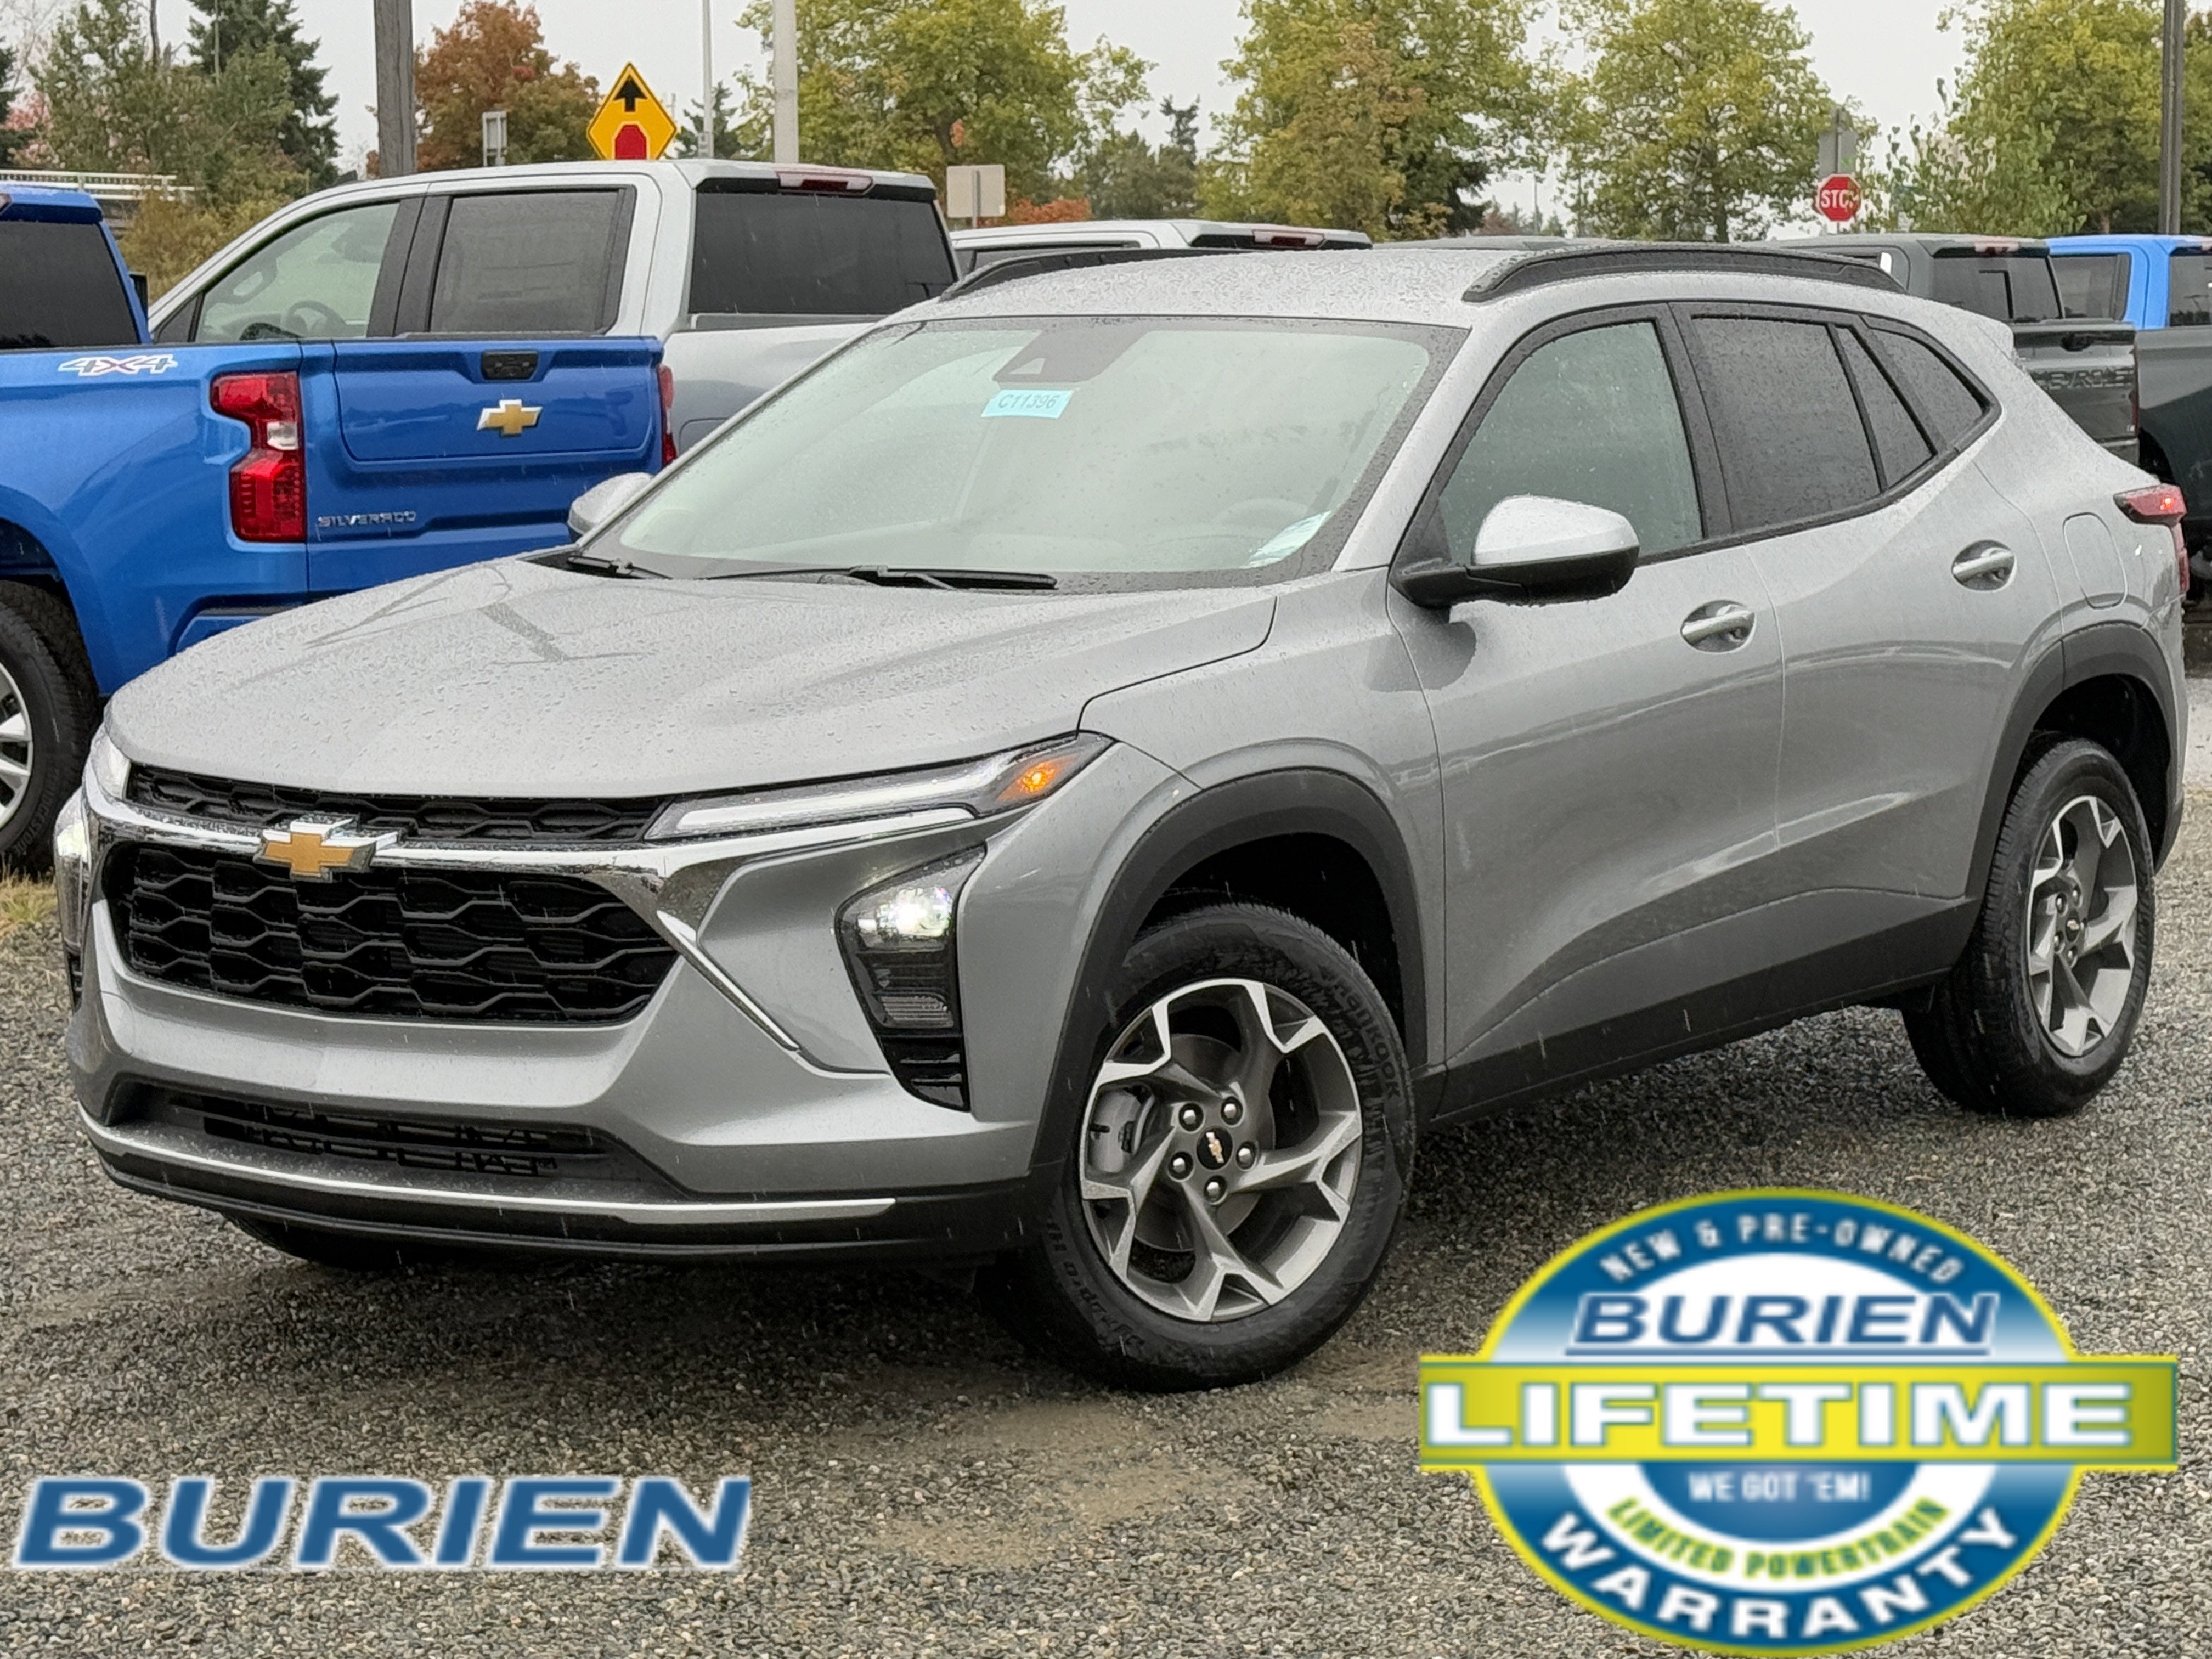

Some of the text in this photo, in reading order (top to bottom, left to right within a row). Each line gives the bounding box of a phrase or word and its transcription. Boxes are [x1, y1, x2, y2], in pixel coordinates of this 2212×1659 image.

[1821, 189, 1858, 209] STO
[997, 394, 1060, 409] C11396
[318, 511, 416, 527] SILVERADO
